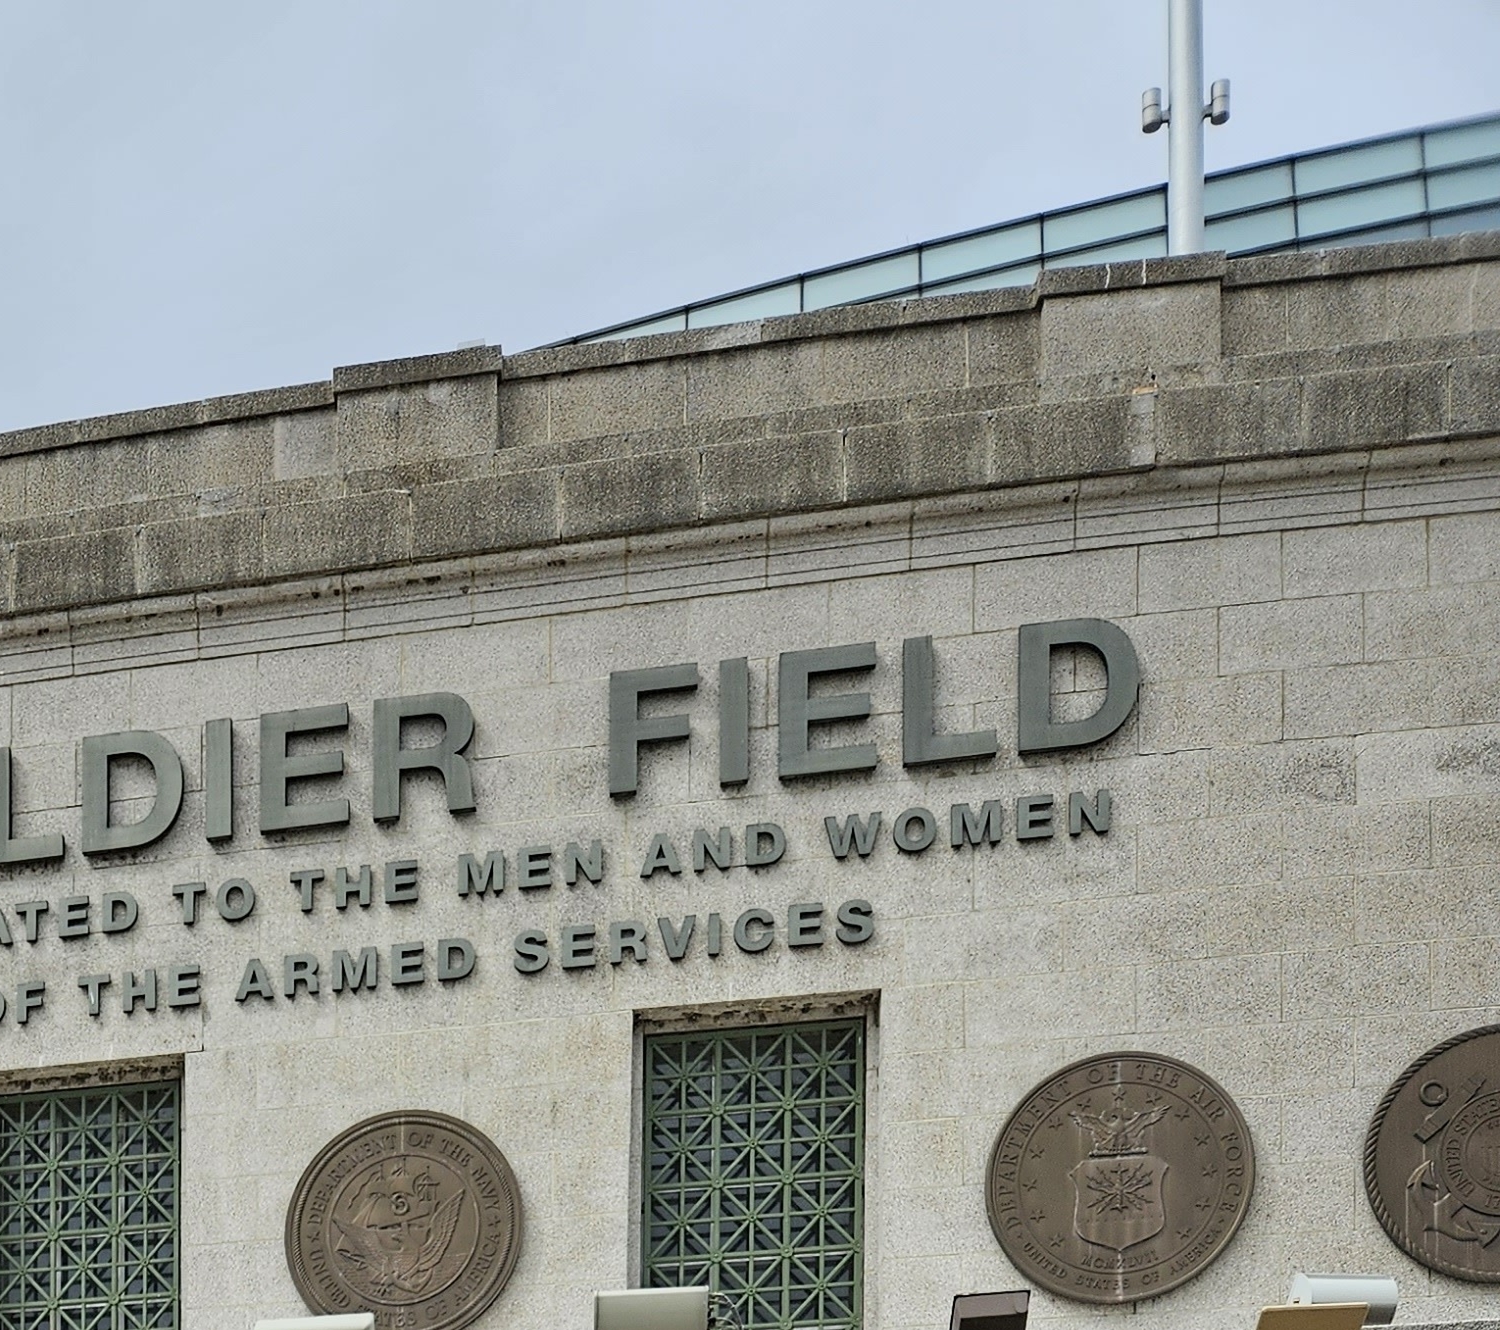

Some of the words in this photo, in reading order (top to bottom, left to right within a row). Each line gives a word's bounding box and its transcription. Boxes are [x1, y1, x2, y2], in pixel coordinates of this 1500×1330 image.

[609, 617, 1140, 799] FIELD
[172, 877, 257, 926] TO
[290, 860, 419, 912] THE
[457, 840, 605, 898] MEN
[640, 822, 787, 879] AND
[825, 789, 1112, 859] WOMEN
[78, 965, 202, 1017] THE
[235, 937, 477, 1002] ARMED
[513, 900, 875, 975] SERVICES
[307, 1133, 398, 1226] DEPARTMENT
[407, 1131, 434, 1151] OF
[442, 1138, 475, 1168] THE
[470, 1164, 502, 1213] NAVY
[999, 1080, 1072, 1233] DEPARTMENT
[1085, 1063, 1119, 1083] OF
[1135, 1064, 1181, 1089] THE
[1189, 1086, 1225, 1123] AIR
[1218, 1131, 1245, 1213] FORCE
[454, 1230, 502, 1307] AMERICA
[1023, 1242, 1068, 1279] UNITED
[1141, 1271, 1161, 1284] OF
[1169, 1228, 1223, 1277] AMERICA
